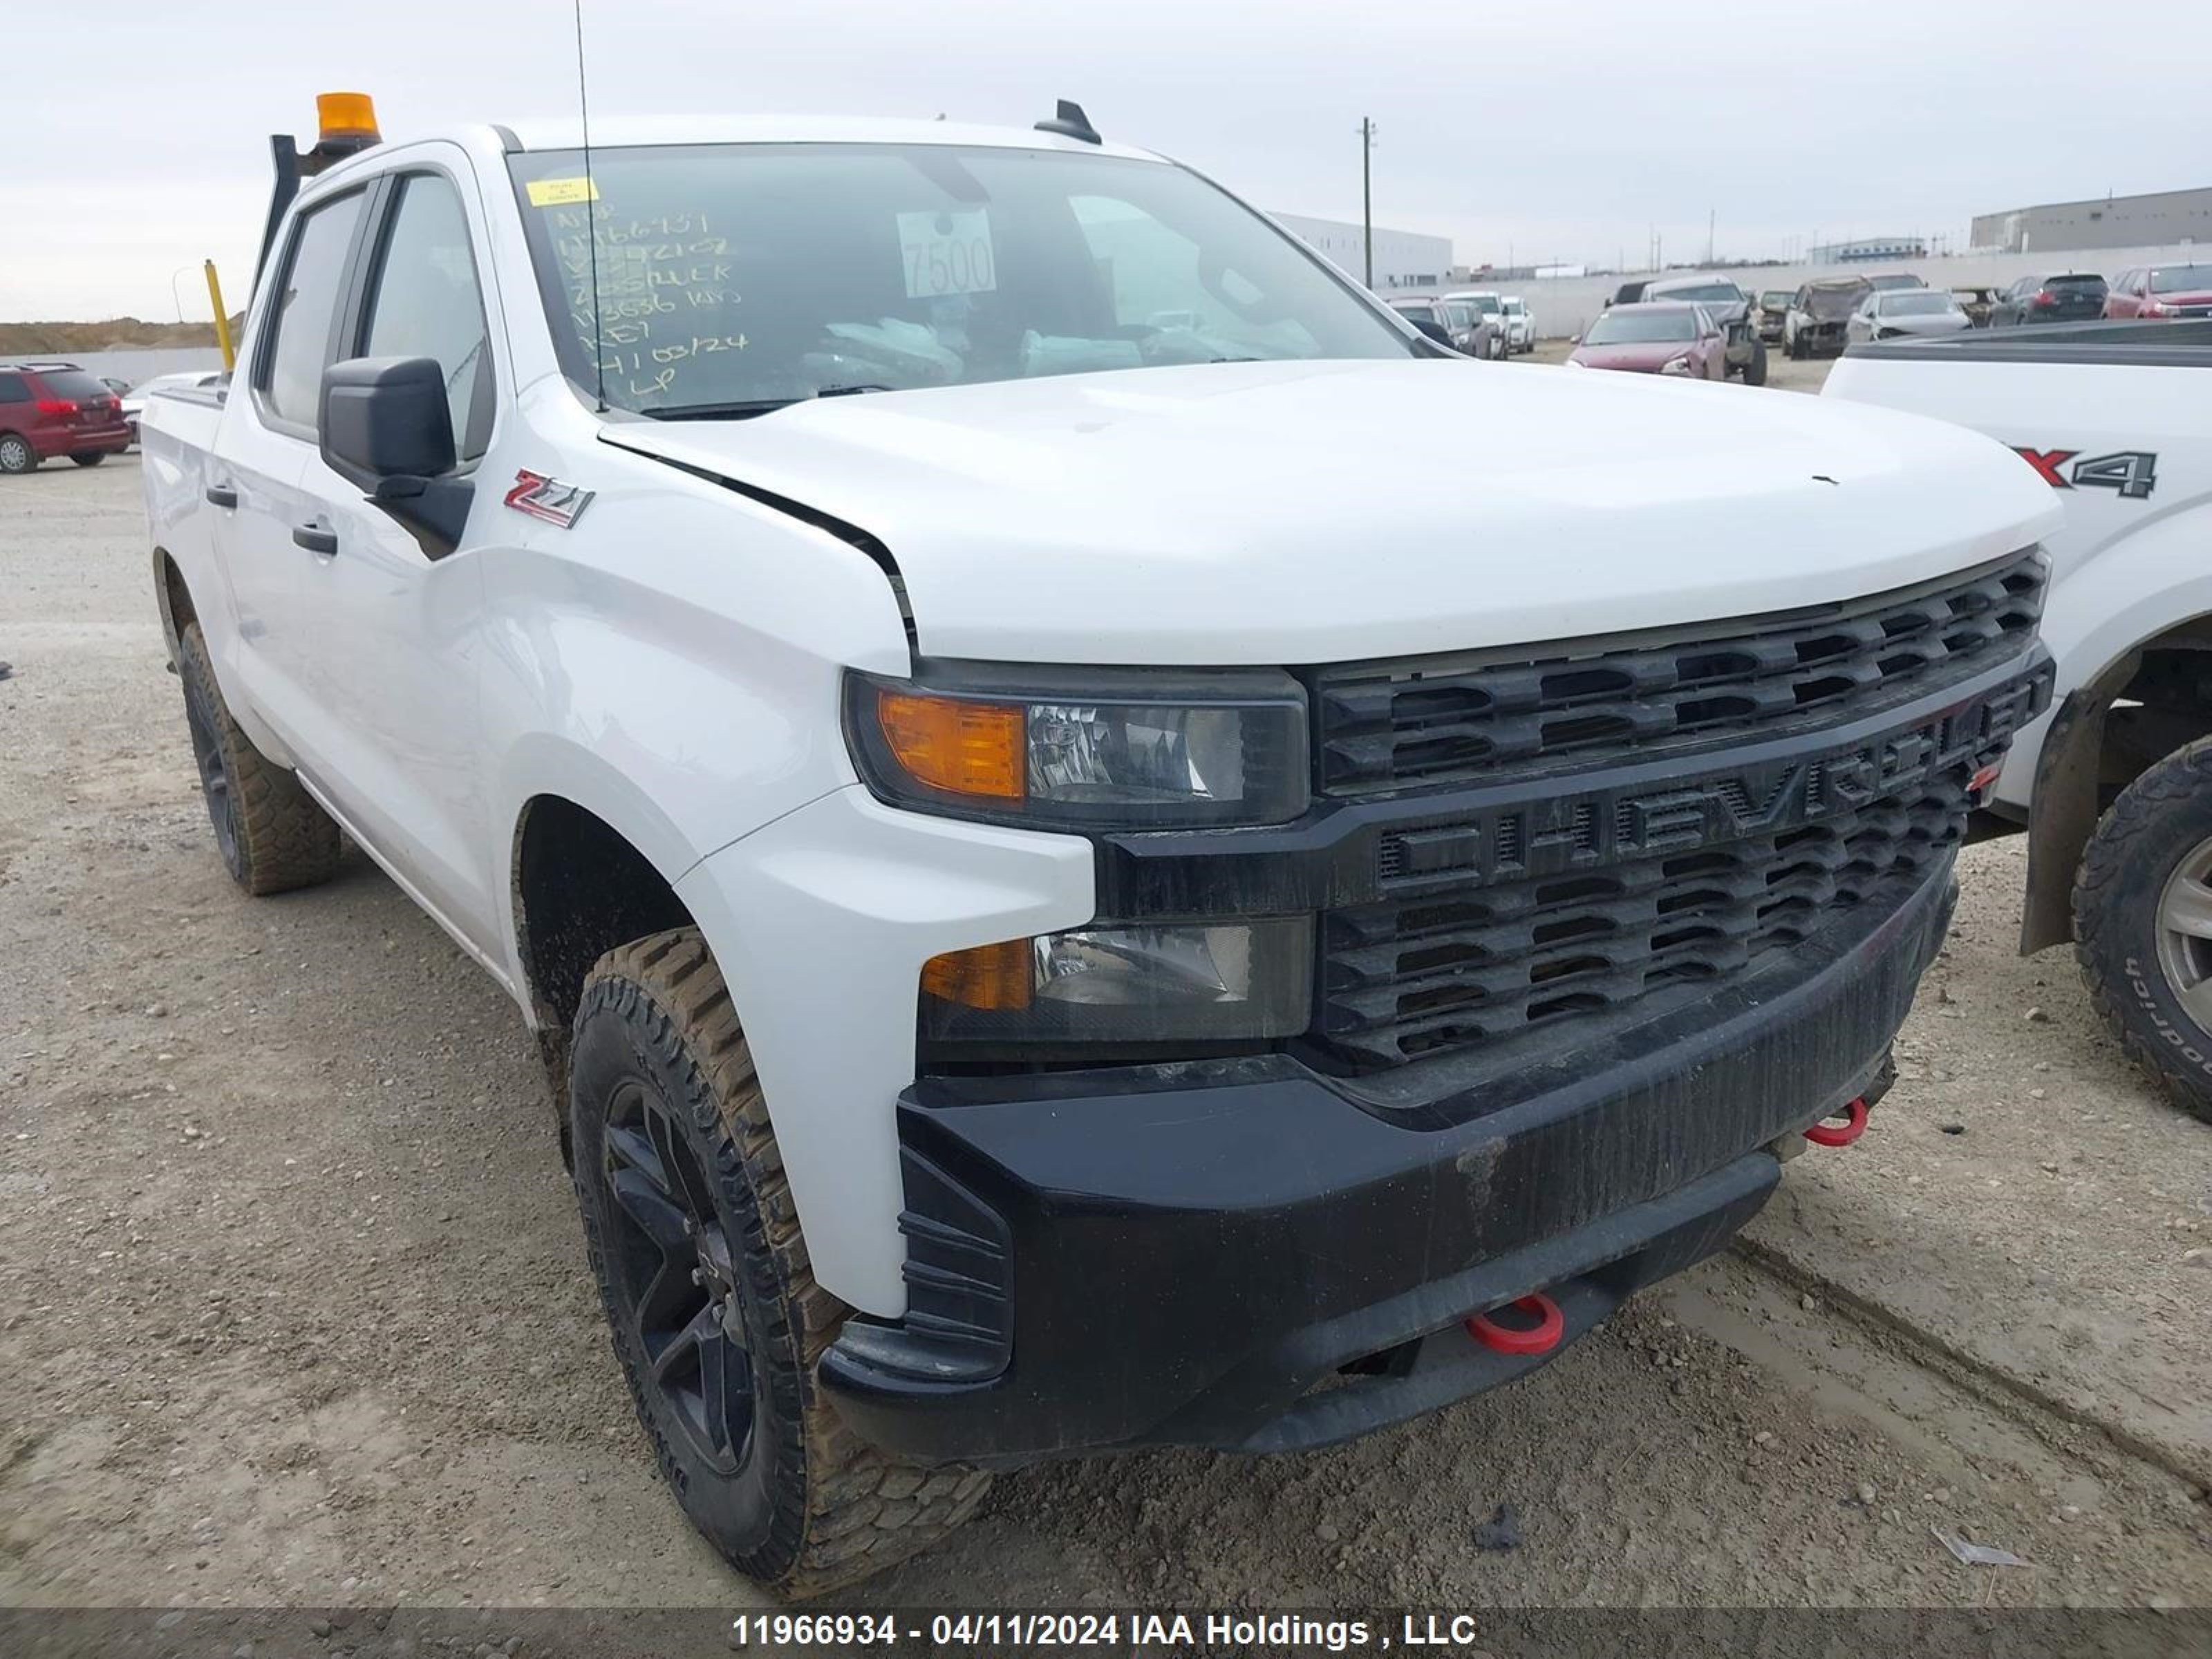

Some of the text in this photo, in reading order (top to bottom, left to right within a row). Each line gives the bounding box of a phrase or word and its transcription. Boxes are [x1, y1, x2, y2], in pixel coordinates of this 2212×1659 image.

[904, 237, 991, 294] 7500
[504, 467, 596, 529] Z71
[1380, 671, 2050, 890] CHEVROLET
